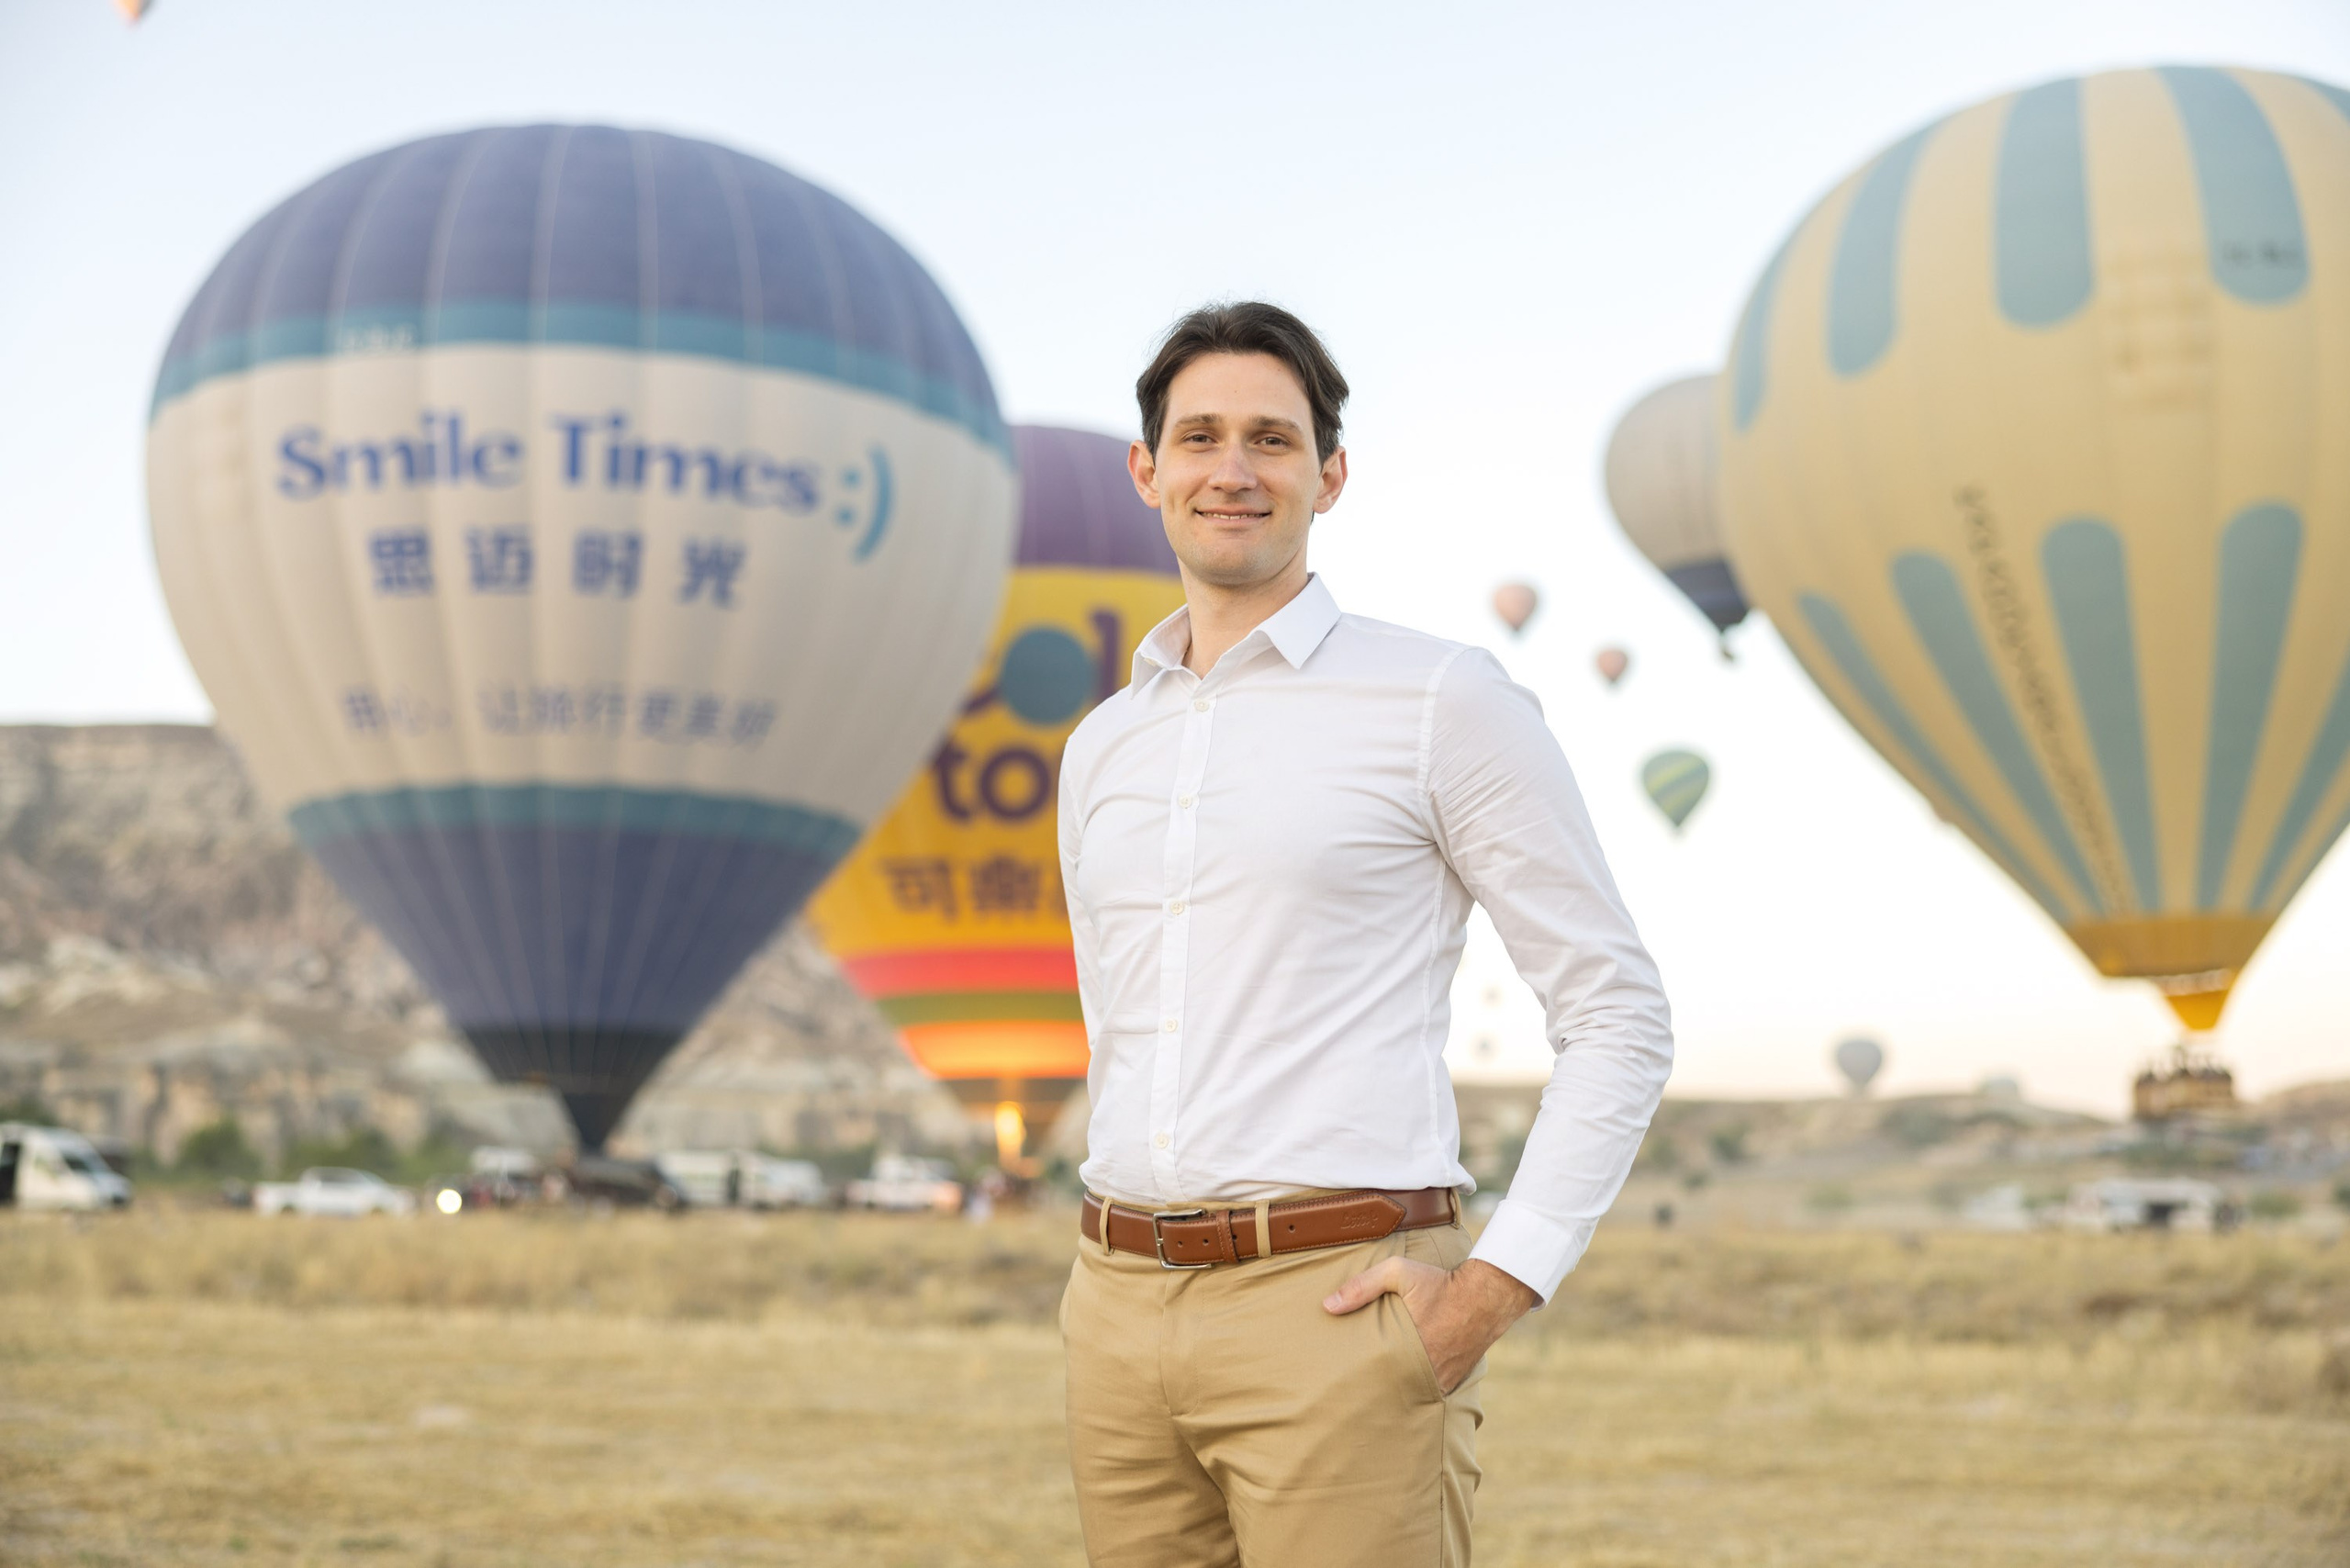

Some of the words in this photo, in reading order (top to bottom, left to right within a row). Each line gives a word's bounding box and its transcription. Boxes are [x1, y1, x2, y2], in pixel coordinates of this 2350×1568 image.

[276, 409, 526, 501] Smile
[547, 409, 822, 515] Times
[932, 742, 1062, 824] to
